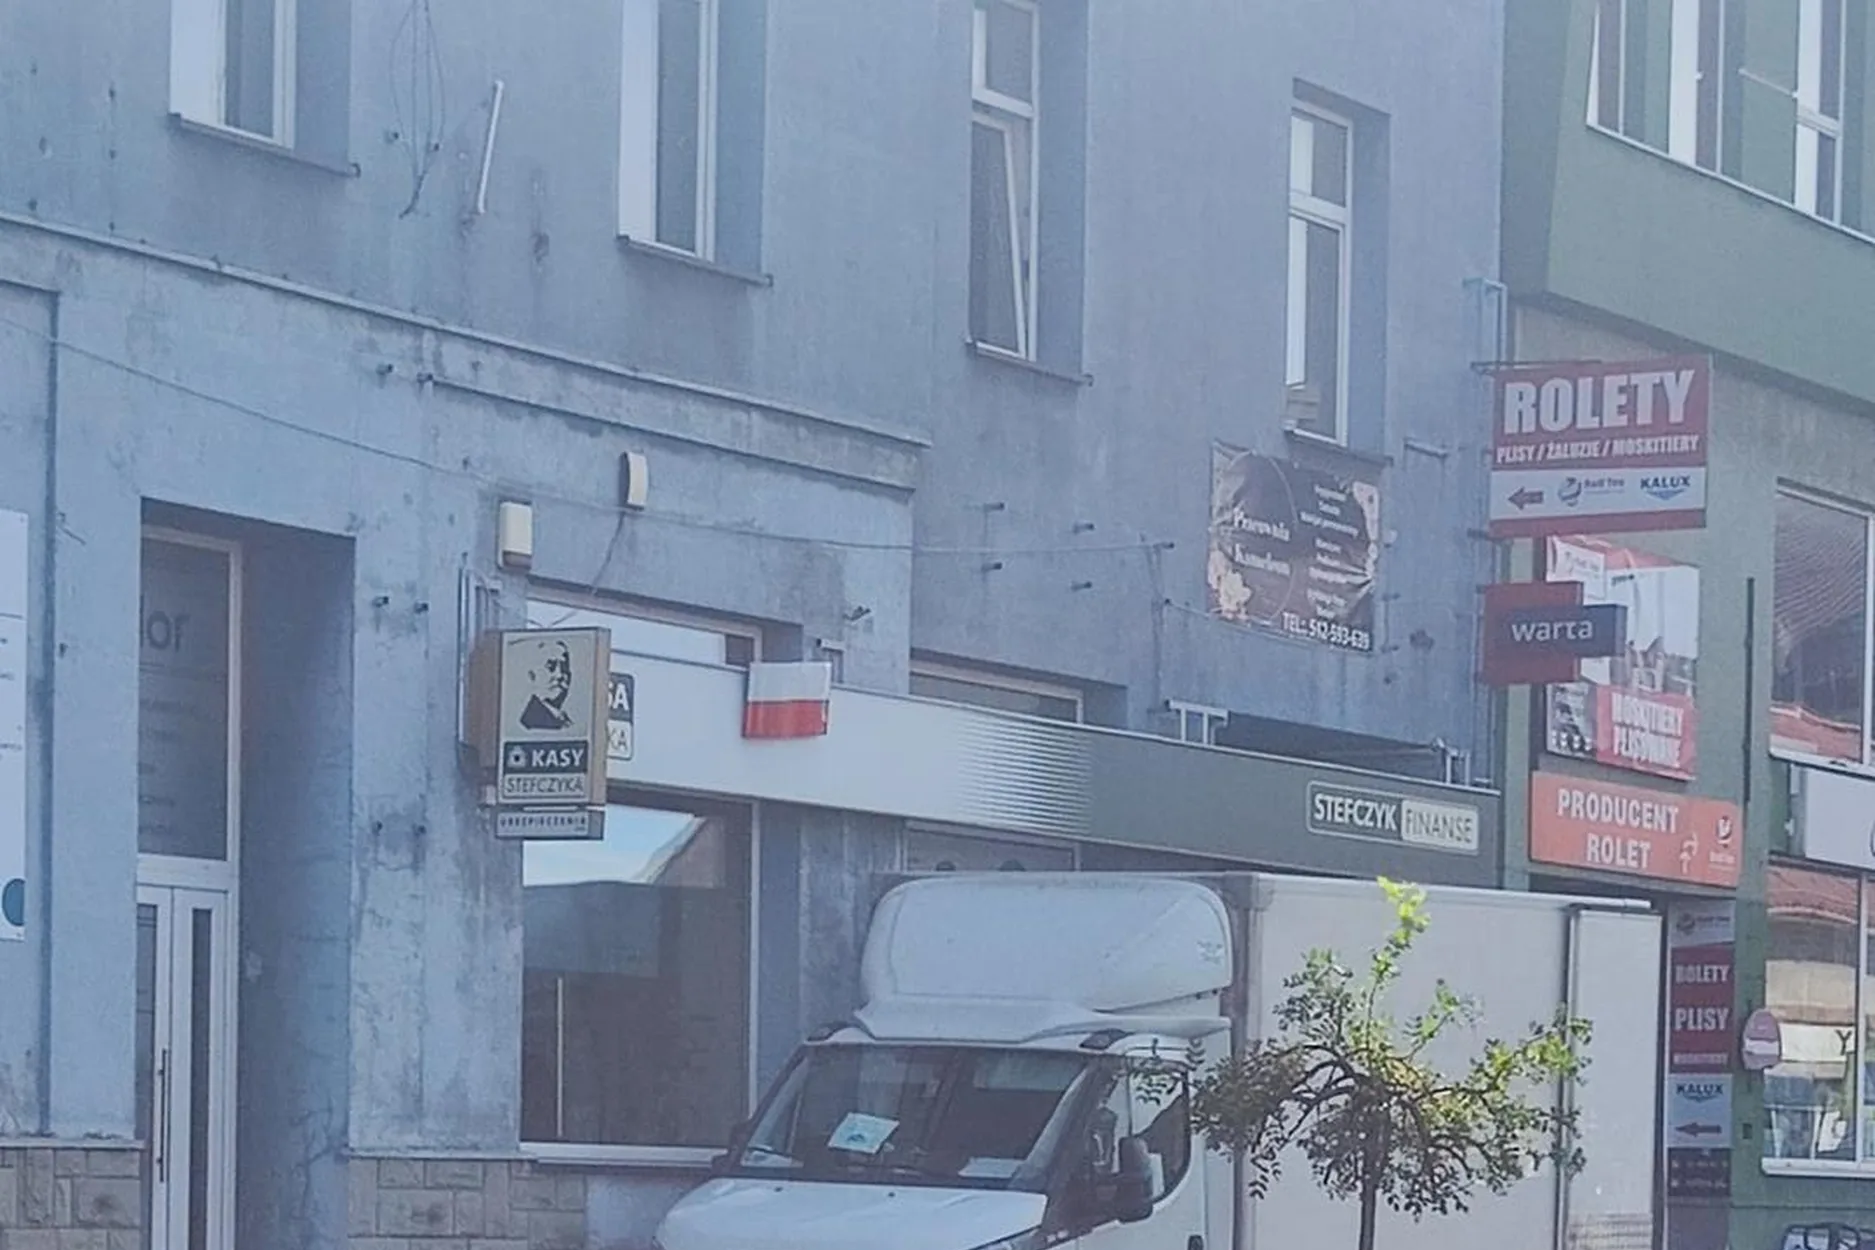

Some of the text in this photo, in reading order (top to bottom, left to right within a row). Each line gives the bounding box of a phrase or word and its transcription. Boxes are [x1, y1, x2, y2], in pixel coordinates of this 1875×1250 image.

[1503, 370, 1695, 434] ROLETY
[1496, 444, 1536, 464] PLISY
[1612, 434, 1699, 457] MOSKITIERY
[1640, 475, 1690, 490] KALUX
[1511, 620, 1593, 642] warta
[531, 748, 584, 767] KASY
[506, 776, 584, 793] STEFCZYKA
[1313, 792, 1474, 845] STEFCZYK FINANSE
[1557, 787, 1680, 834] PRODUCENT
[1586, 832, 1651, 869] ROLET
[1675, 964, 1730, 984] ROLETY
[1674, 1007, 1729, 1033] PLISY
[1675, 1083, 1724, 1096] KALUX
